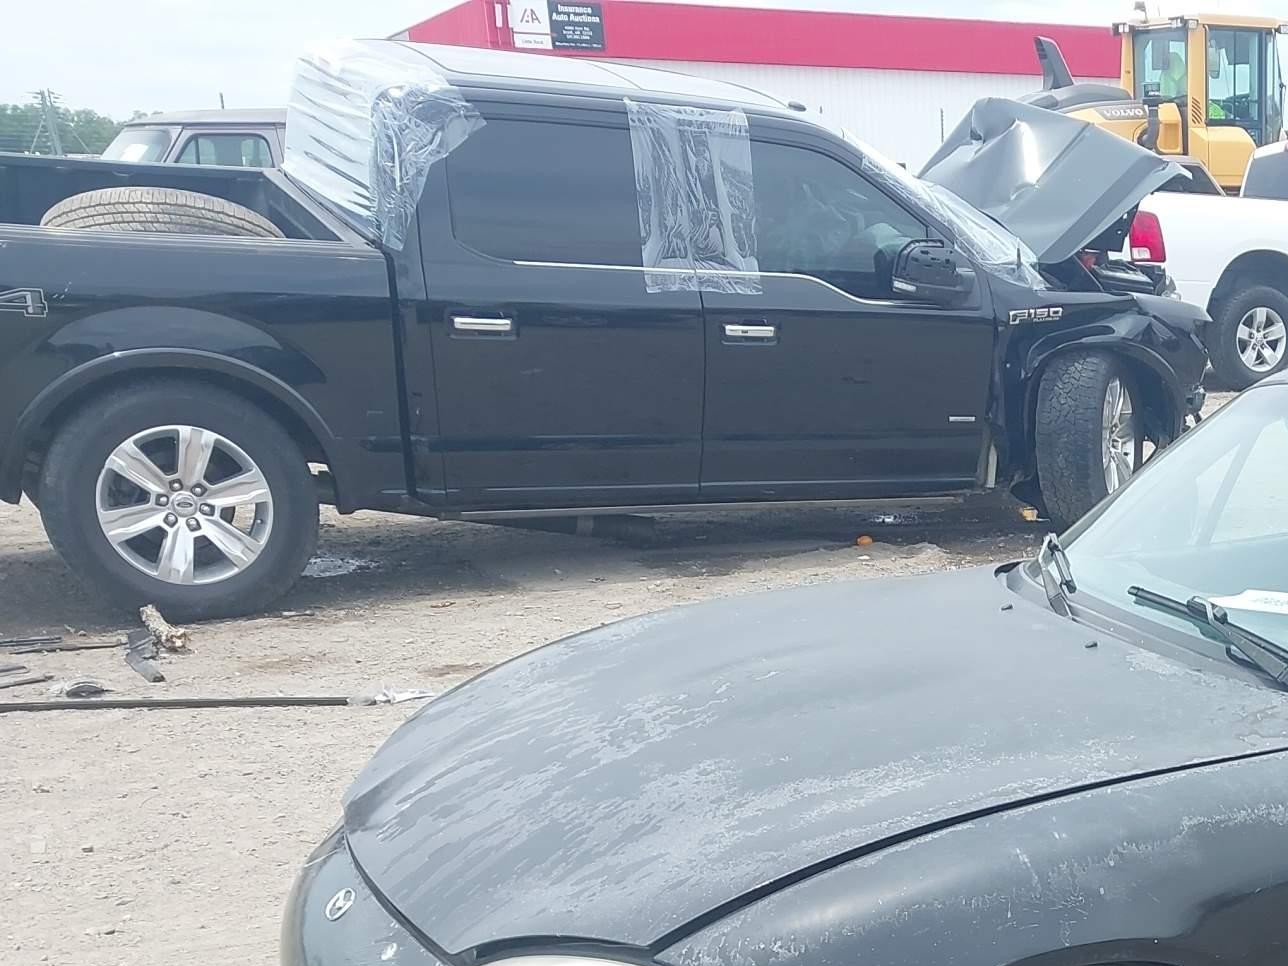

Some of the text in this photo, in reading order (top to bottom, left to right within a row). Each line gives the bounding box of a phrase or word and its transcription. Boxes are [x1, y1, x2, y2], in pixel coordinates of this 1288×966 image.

[557, 4, 592, 14] Insurance
[552, 12, 600, 23] Auto Auctions
[1103, 108, 1144, 117] VOLVO
